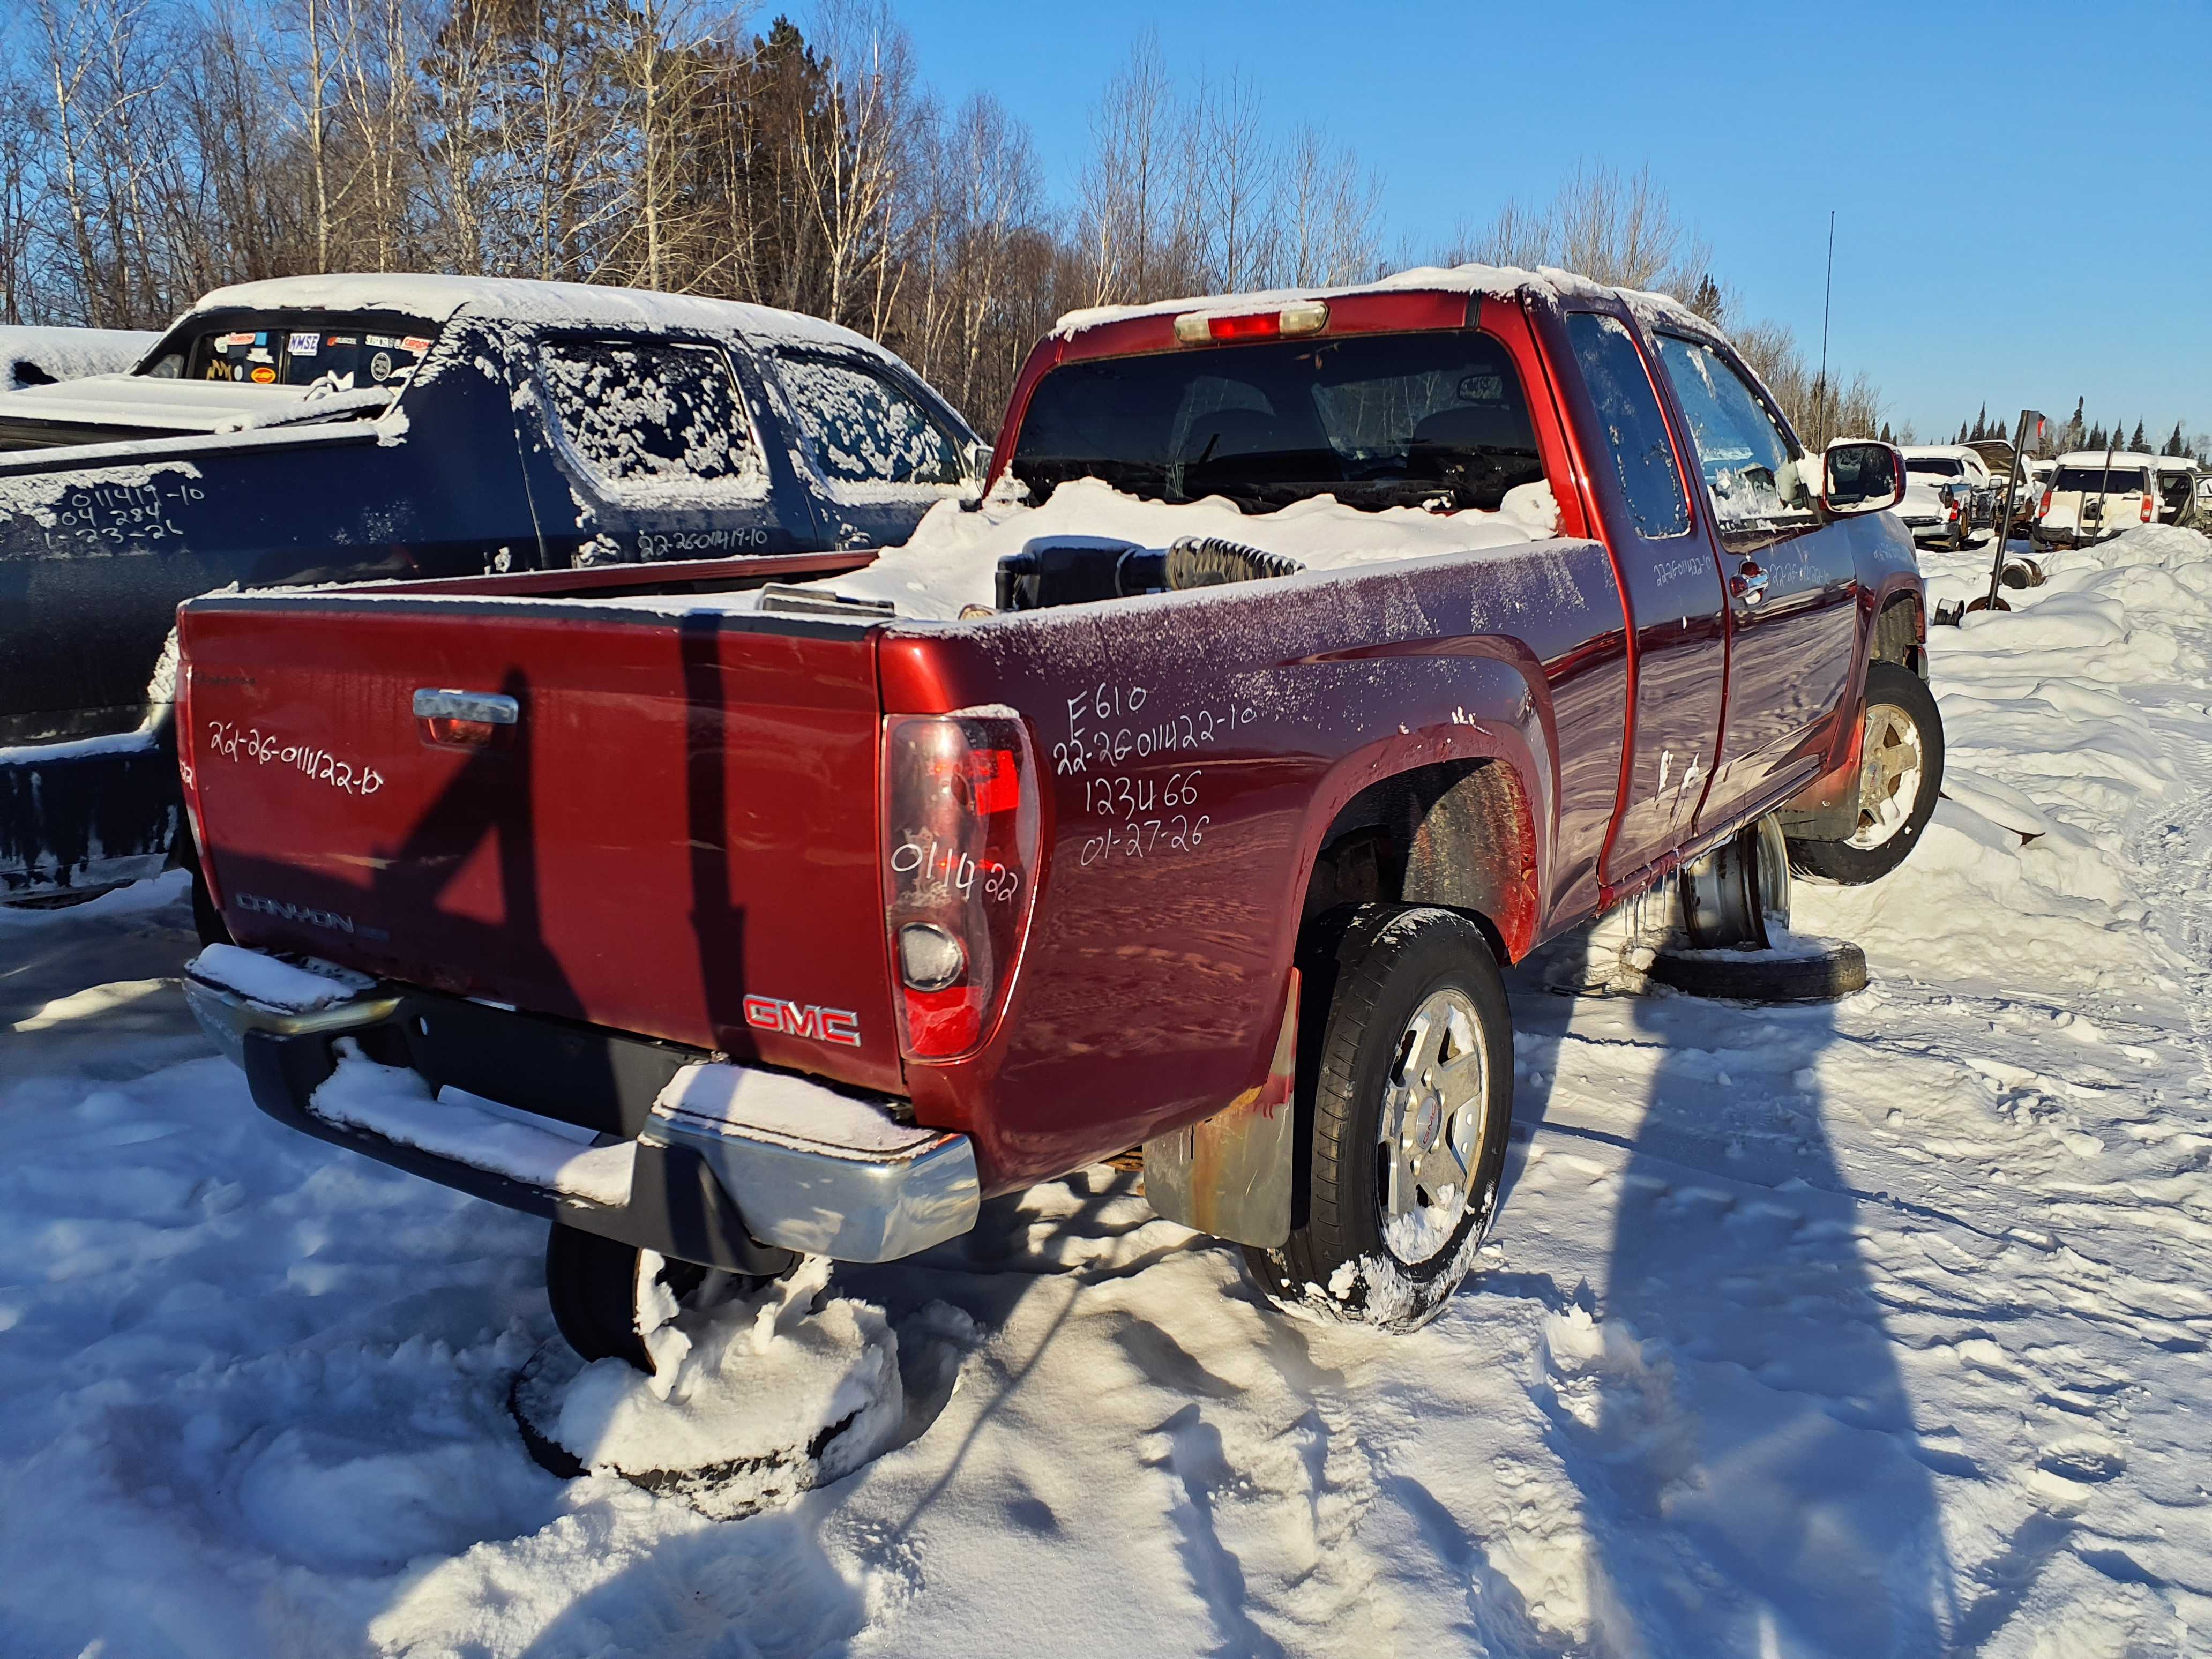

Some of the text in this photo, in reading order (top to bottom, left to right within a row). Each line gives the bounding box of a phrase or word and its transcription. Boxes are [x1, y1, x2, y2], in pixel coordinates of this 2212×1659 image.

[1081, 815, 1210, 866] 01-27-26
[236, 892, 354, 933] CANYON
[743, 994, 862, 1047] GMC
[1423, 1103, 1437, 1144] GMC
